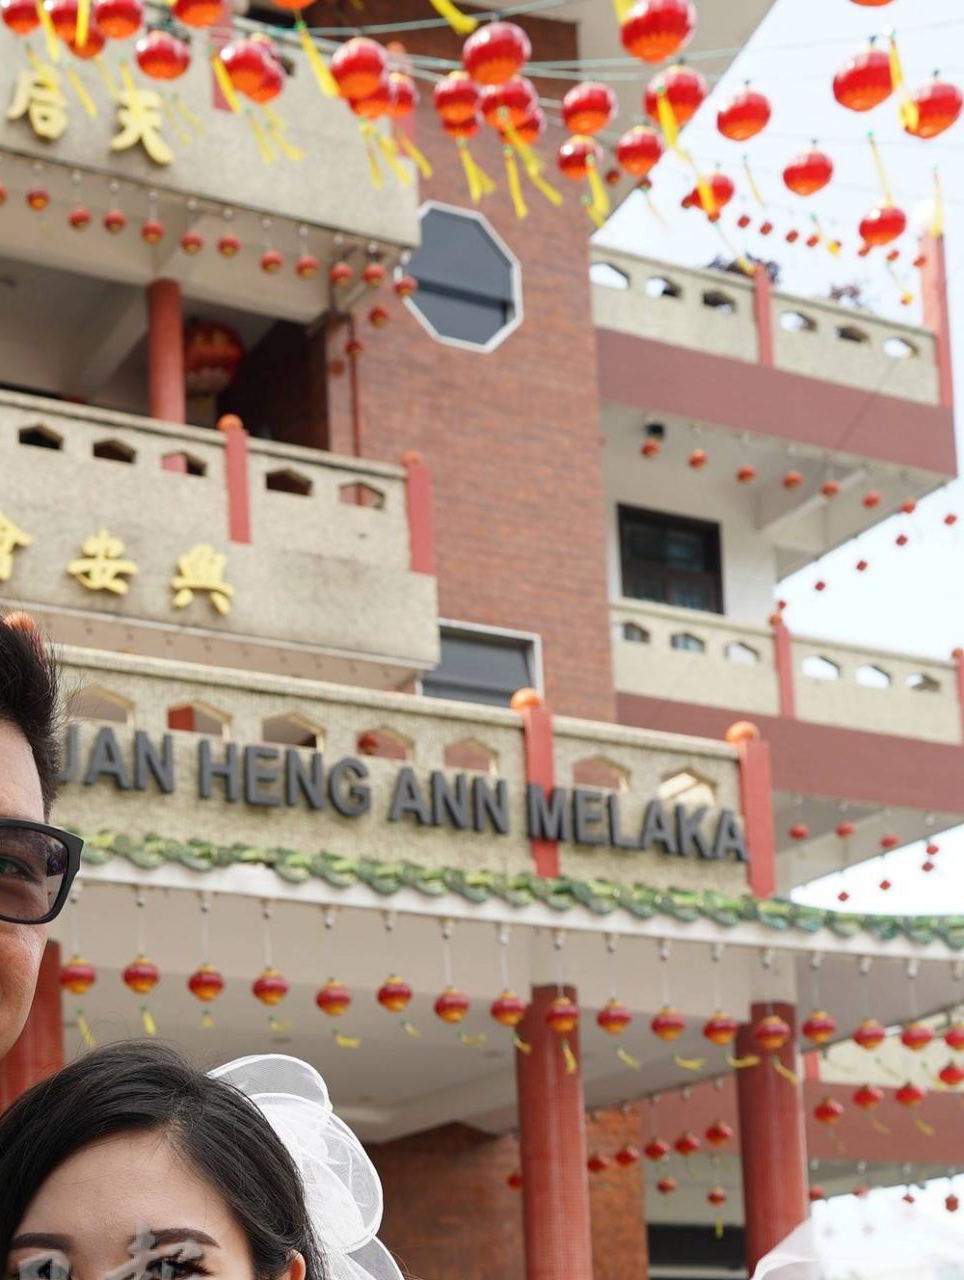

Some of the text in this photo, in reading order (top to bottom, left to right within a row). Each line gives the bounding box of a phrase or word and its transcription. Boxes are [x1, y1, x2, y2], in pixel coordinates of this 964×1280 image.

[197, 738, 371, 818] HENG
[388, 766, 509, 834] ANN
[525, 783, 750, 863] MELAKA
